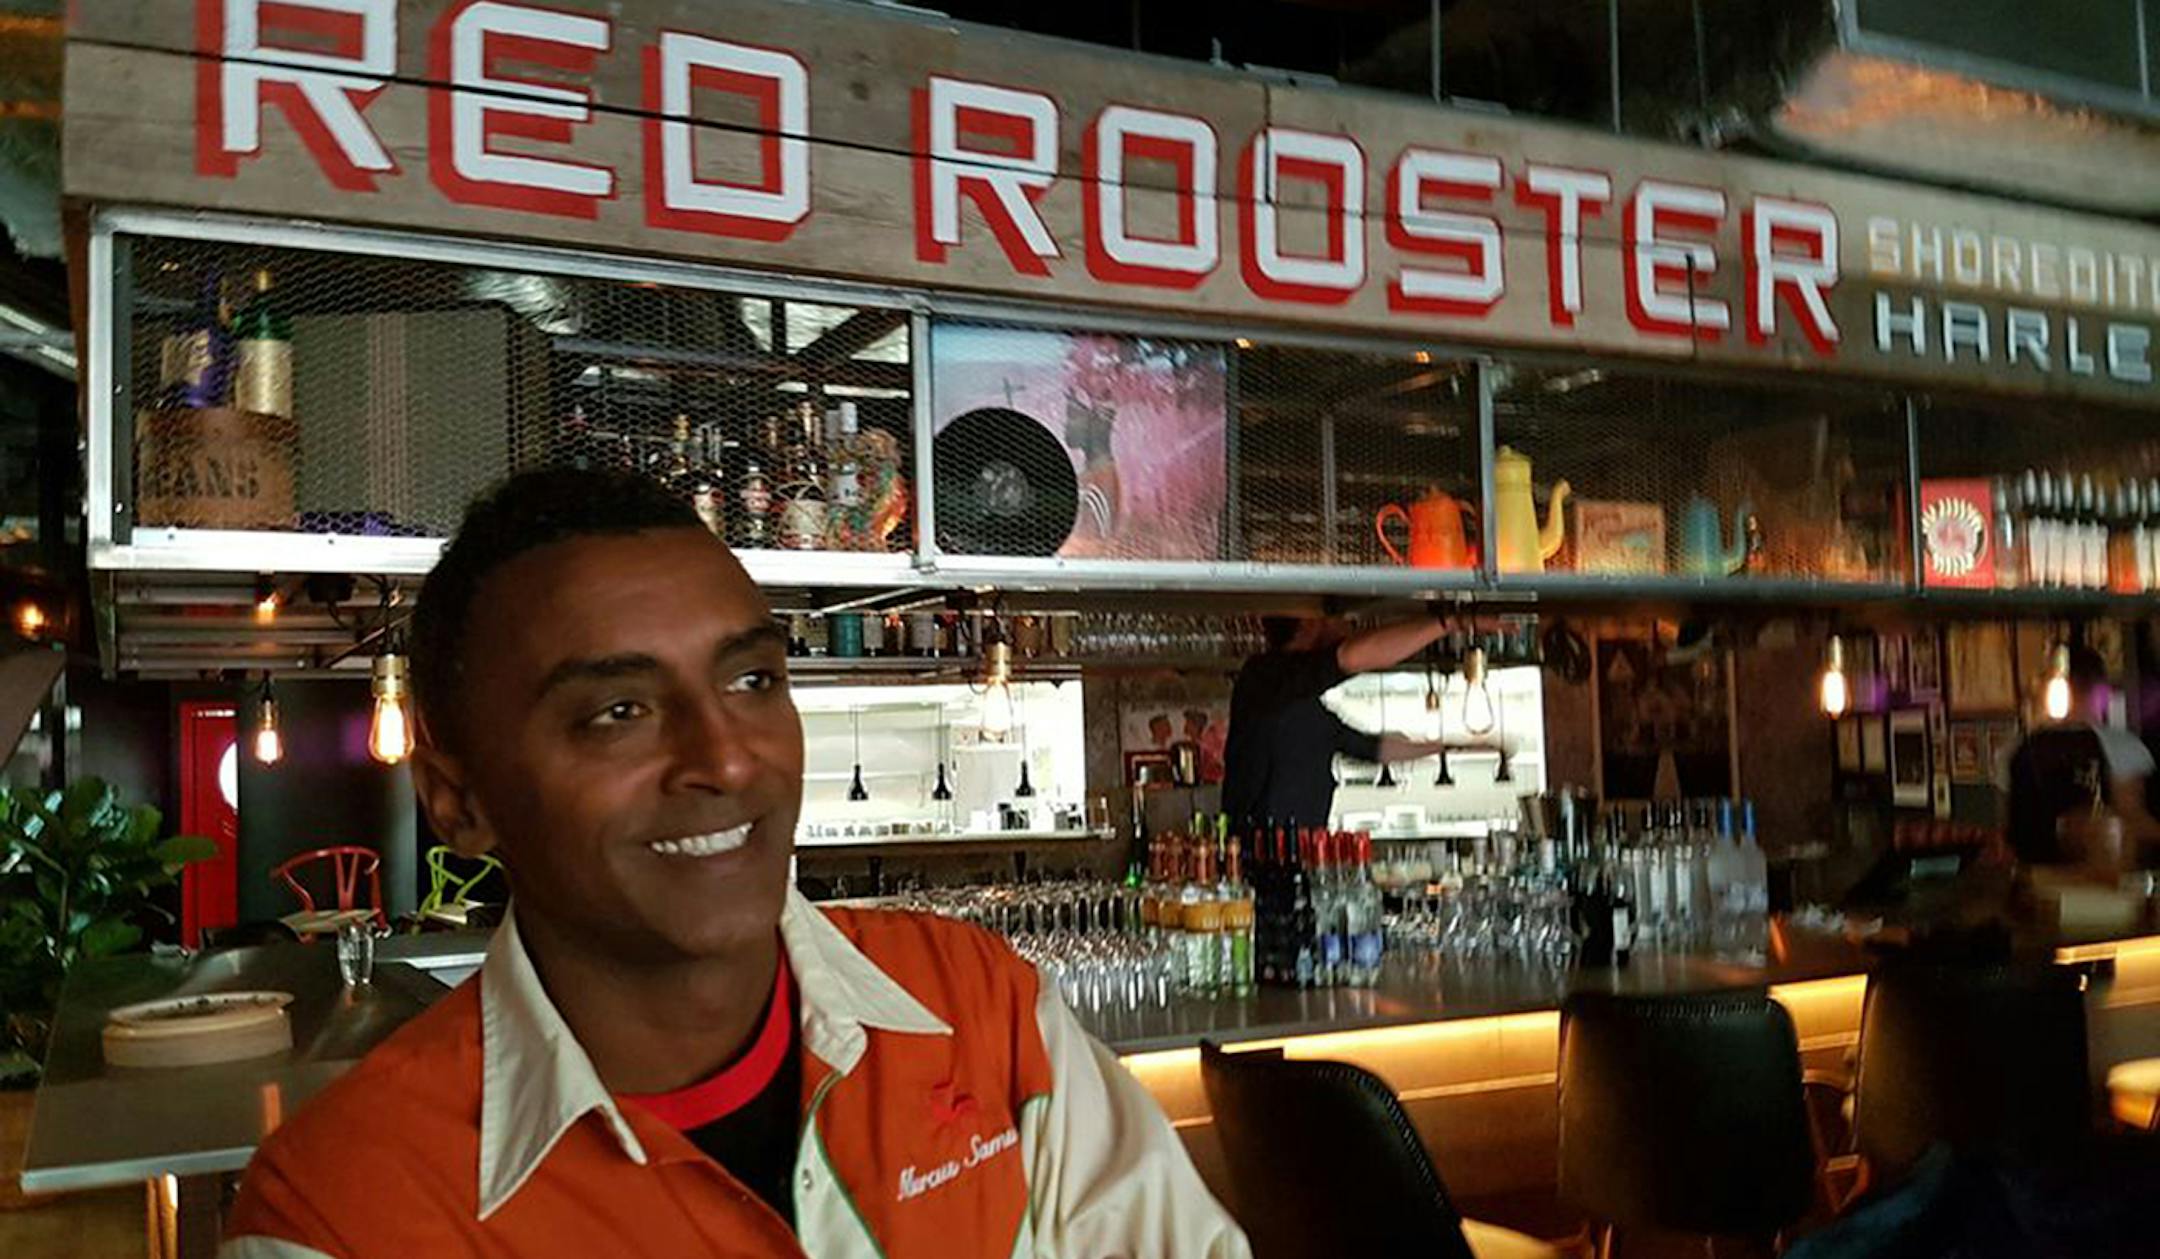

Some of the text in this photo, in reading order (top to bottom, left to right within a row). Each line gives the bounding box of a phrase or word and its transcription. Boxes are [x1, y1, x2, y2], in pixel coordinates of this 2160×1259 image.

[197, 0, 1841, 354] RED ROOSTER
[1874, 290, 2151, 383] HARLE
